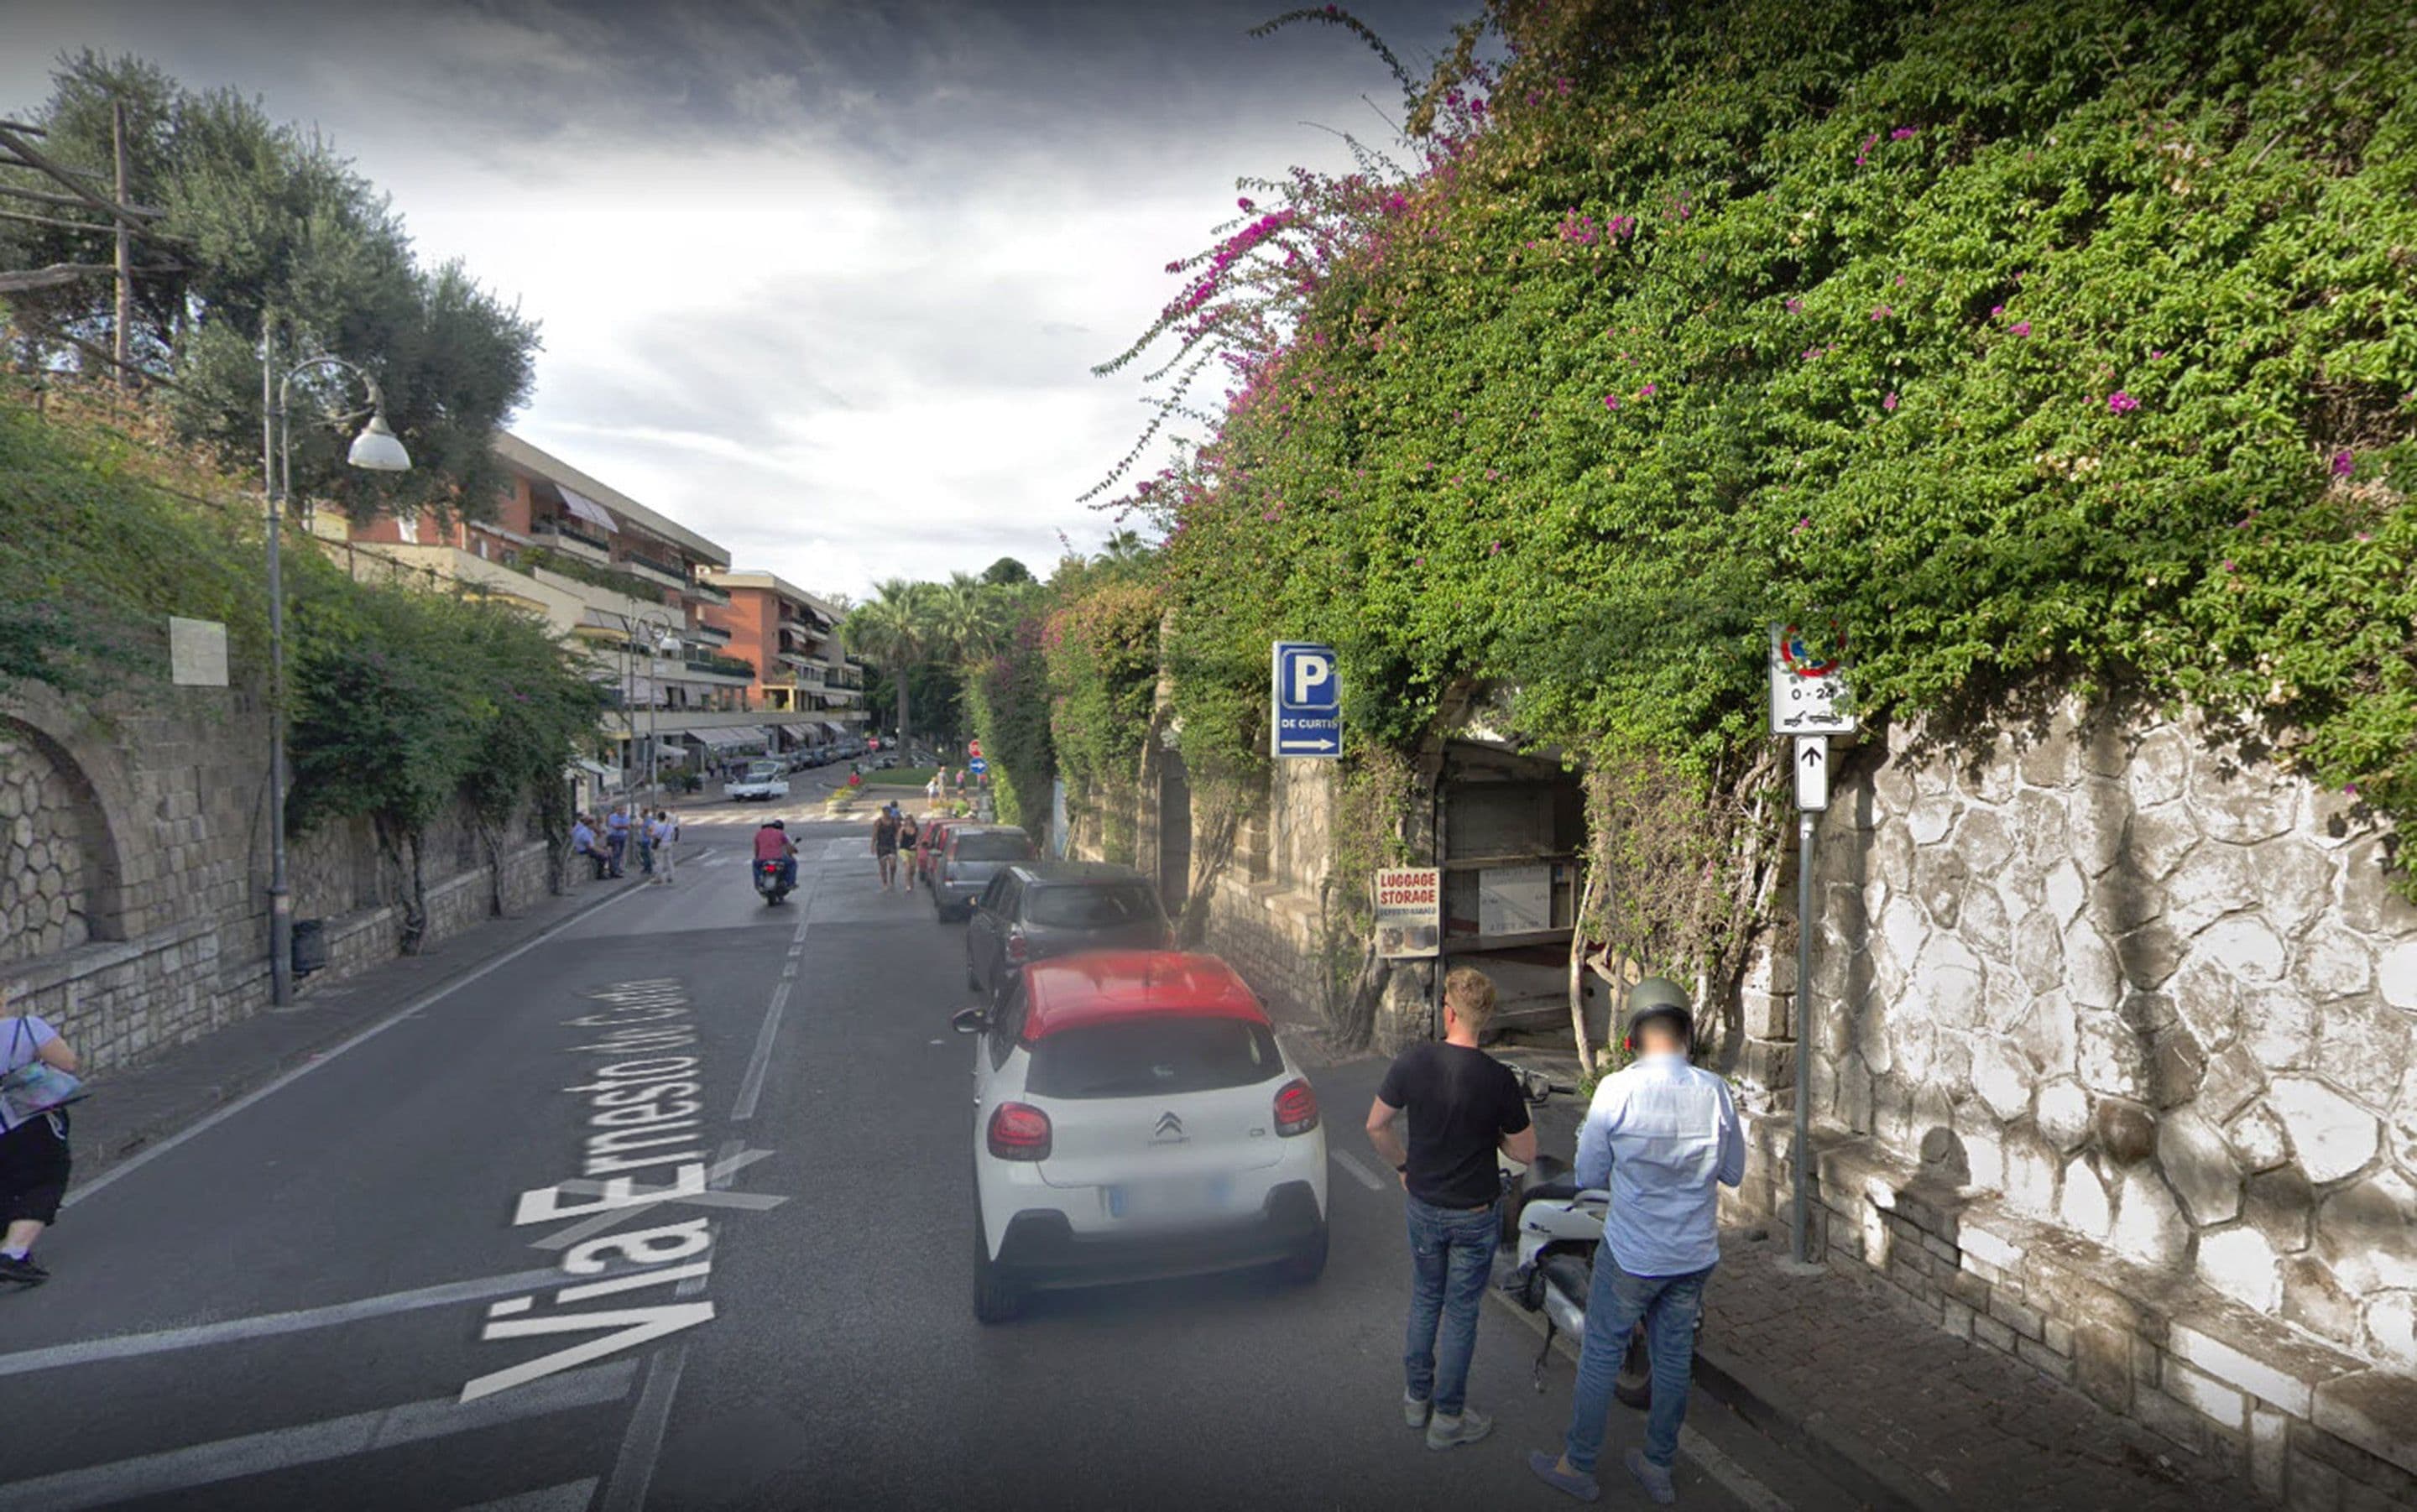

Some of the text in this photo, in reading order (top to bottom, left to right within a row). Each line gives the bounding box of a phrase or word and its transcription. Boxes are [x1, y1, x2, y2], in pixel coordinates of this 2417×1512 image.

[1295, 654, 1329, 703] P
[1791, 688, 1802, 701] 0
[1282, 718, 1338, 730] DE CURTIS
[1381, 873, 1436, 888] LUGGAGE
[1381, 889, 1436, 905] STORAGE
